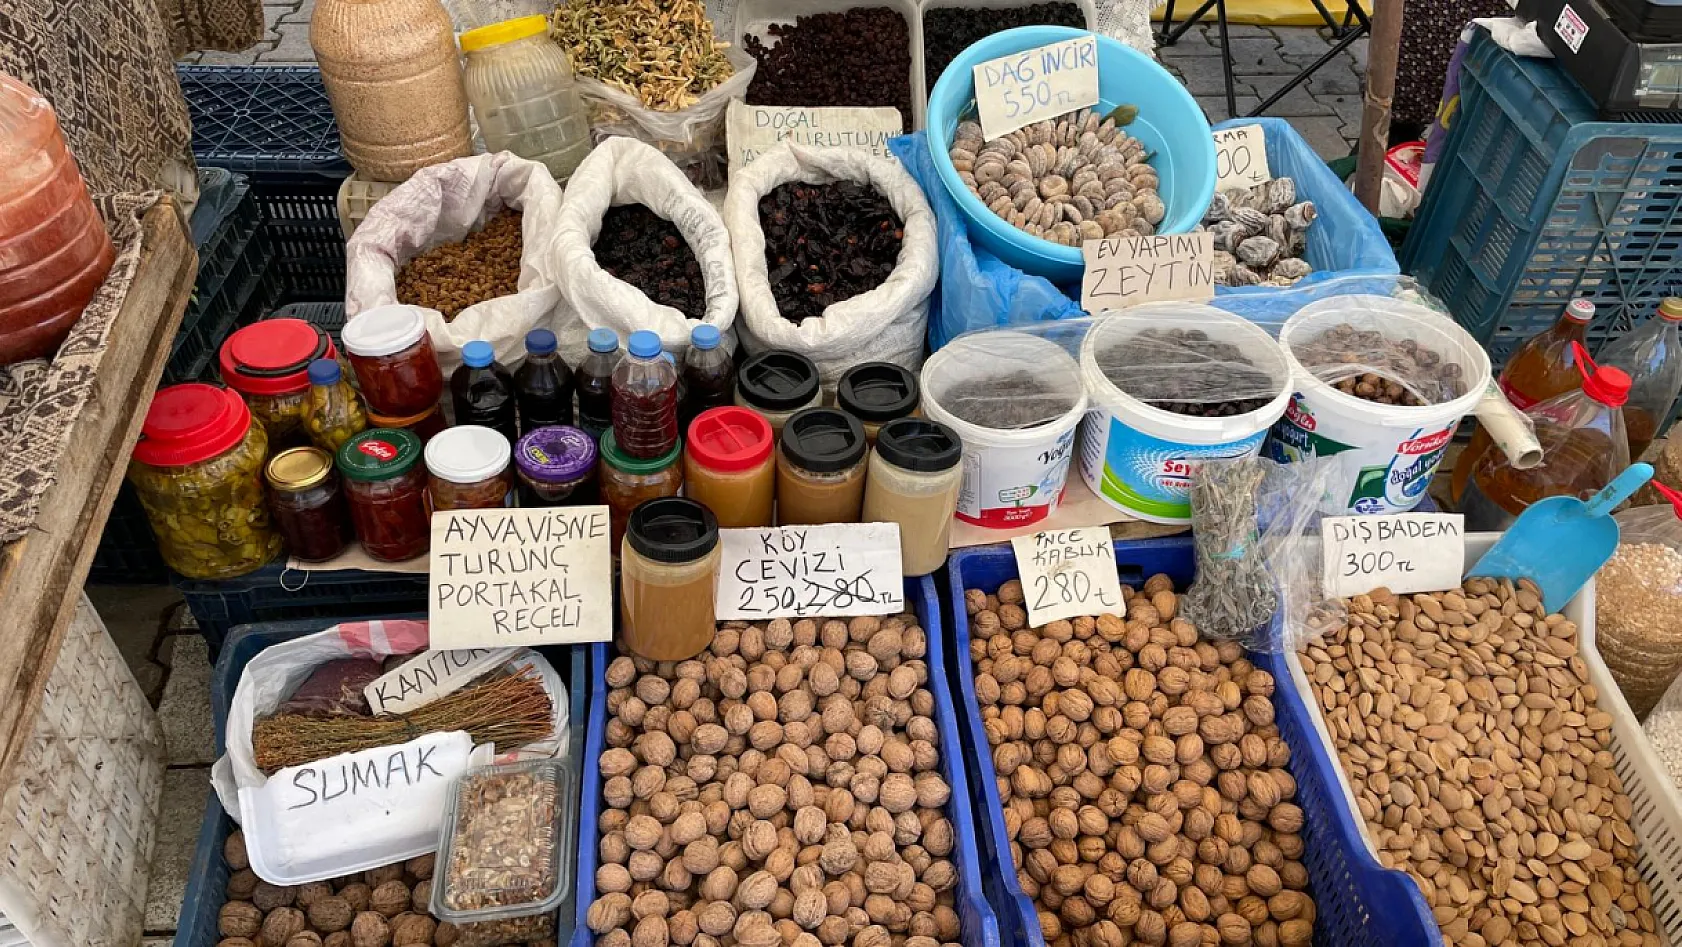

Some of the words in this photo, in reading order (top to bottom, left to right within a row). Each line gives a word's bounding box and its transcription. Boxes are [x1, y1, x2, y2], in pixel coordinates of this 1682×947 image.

[755, 108, 820, 129] DOĞAL
[777, 130, 903, 148] KURUTULM
[1097, 239, 1121, 259] EV
[1127, 235, 1203, 260] YAPIMI
[1089, 256, 1214, 298] ZEYTİN
[760, 529, 807, 555] KÖY
[1333, 518, 1372, 544] DİŞ
[1377, 519, 1458, 541] BADEM
[439, 545, 569, 576] TURUNÇ
[735, 546, 845, 583] CEVİZİ
[1032, 541, 1112, 566] KABUK
[438, 578, 580, 609] PORTAKAL
[287, 745, 443, 810] SUMAK
